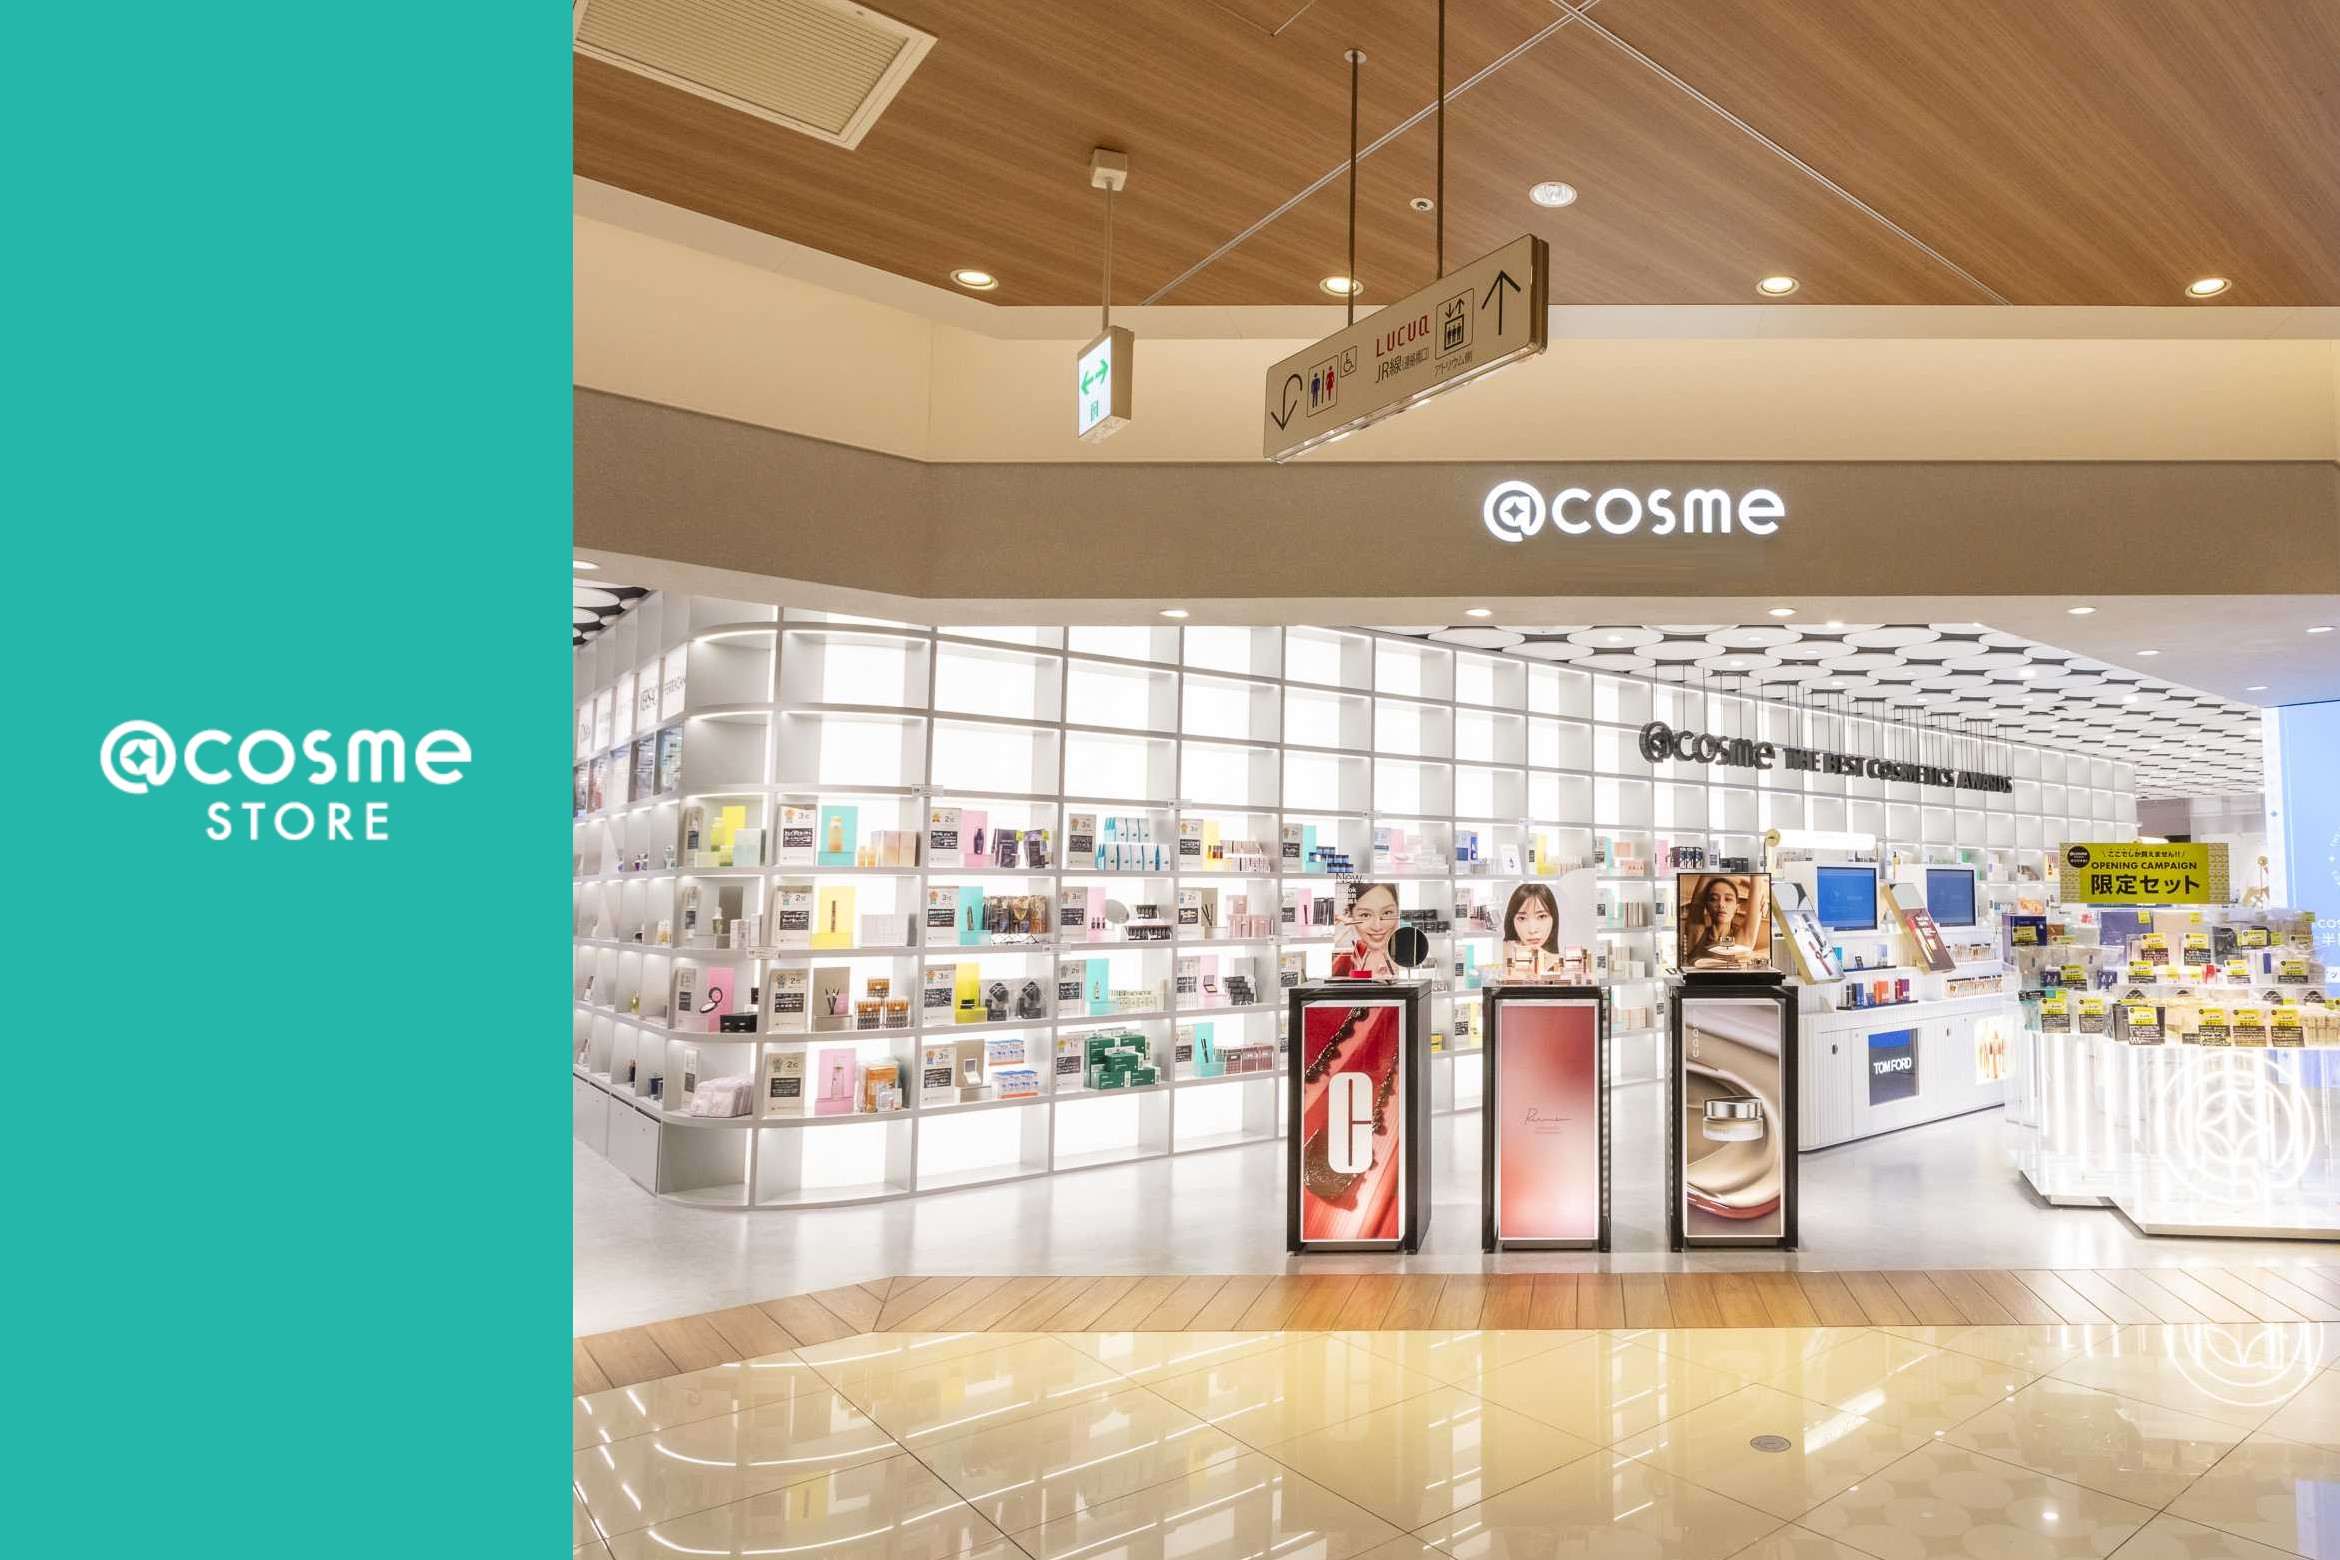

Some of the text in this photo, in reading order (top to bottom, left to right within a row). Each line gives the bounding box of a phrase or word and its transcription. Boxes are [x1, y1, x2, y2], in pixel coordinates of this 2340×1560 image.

[1483, 480, 1786, 543] @cosme
[1639, 721, 2013, 794] @cosme THE BEST COSMETICS AWARDS
[2091, 861, 2198, 870] OPENING CAMPAIGN
[2091, 874, 2200, 895] 限定セット
[1873, 1057, 1912, 1075] TOM FORD
